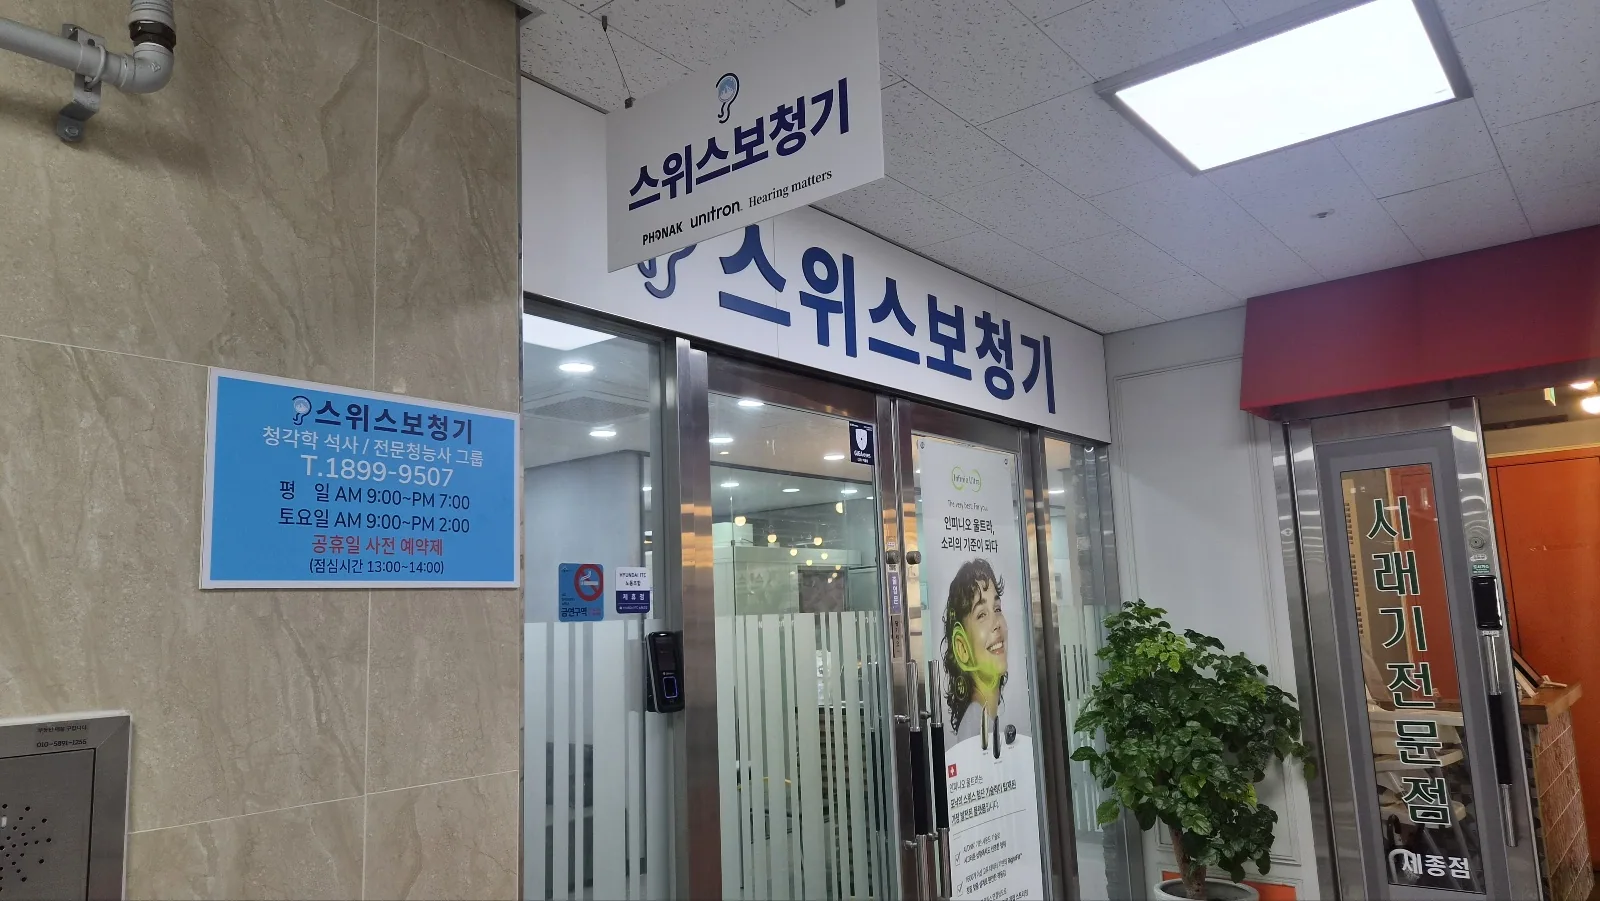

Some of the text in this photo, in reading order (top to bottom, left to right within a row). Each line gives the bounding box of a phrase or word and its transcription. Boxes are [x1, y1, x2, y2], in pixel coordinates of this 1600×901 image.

[628, 77, 849, 211] 스위스보청기
[642, 221, 683, 246] PHONAK
[748, 185, 789, 208] Hearing
[791, 170, 832, 194] matters
[718, 223, 1056, 415] 스위스보청기
[314, 400, 472, 445] 스위스보청기
[262, 425, 319, 450] 청각학
[324, 433, 360, 455] 석사
[373, 438, 452, 465] 전문청능사
[455, 449, 484, 468] 그룹
[300, 454, 454, 487] T.1899-9507
[334, 486, 362, 504] AM
[366, 488, 435, 508] 9:00~PM
[439, 493, 470, 510] 7:00
[278, 507, 470, 533] 토요일 AM 9:00~PM 2:00
[944, 515, 972, 531] 인피니오
[311, 534, 443, 556] 공휴일 사전 예약제
[941, 537, 999, 554] 소리의 기준이 되다
[309, 558, 444, 575] (점심시간 13:00~14:00)
[561, 606, 588, 618] 금연구역
[1366, 496, 1451, 827] 시래기전문점
